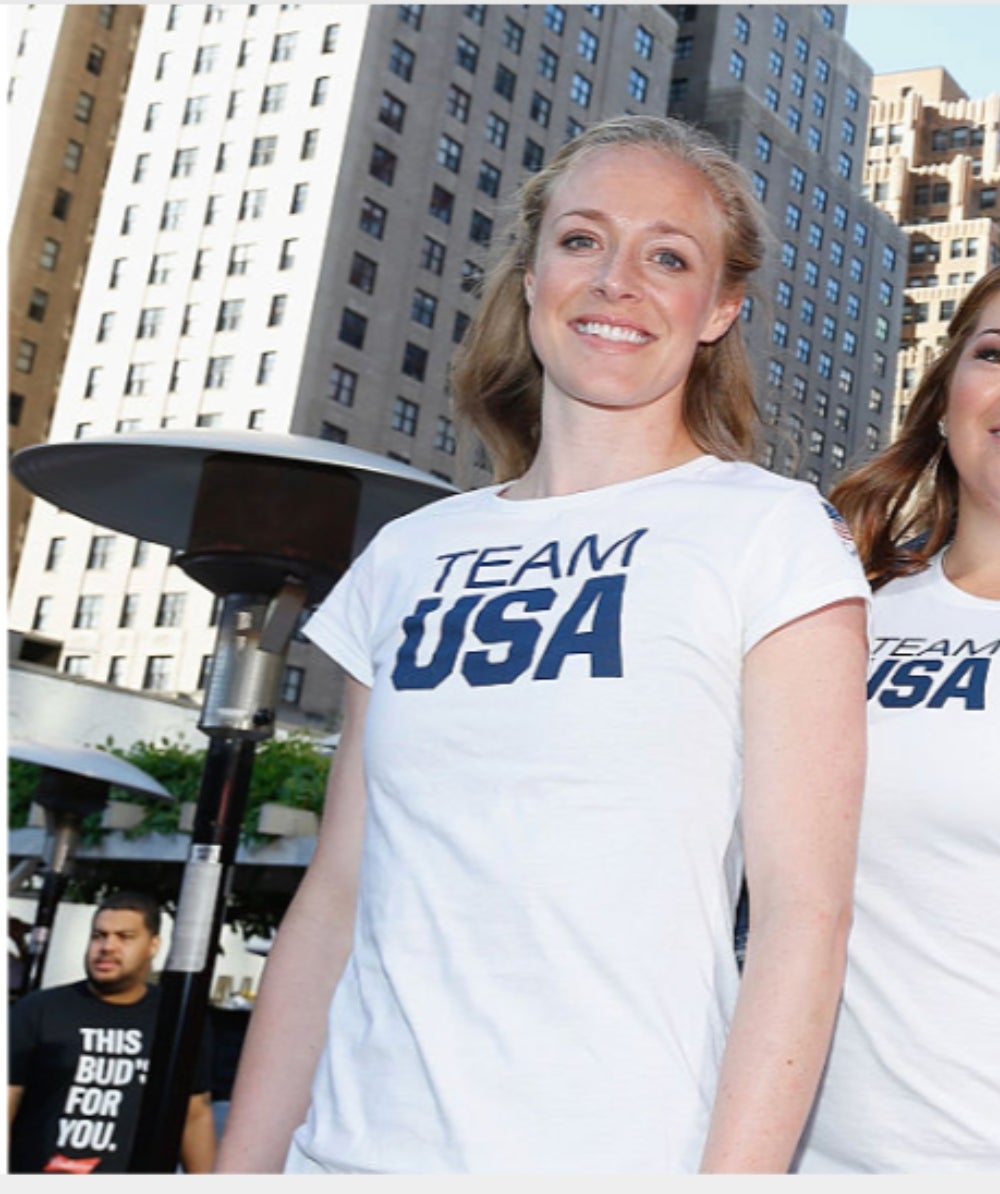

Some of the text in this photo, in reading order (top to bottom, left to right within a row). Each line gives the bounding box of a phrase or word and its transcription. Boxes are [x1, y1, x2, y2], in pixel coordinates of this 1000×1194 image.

[433, 528, 649, 593] TEAM
[391, 573, 627, 692] USA
[79, 1028, 143, 1056] THIS
[64, 1085, 123, 1118] FOR
[56, 1118, 117, 1152] YOU.
